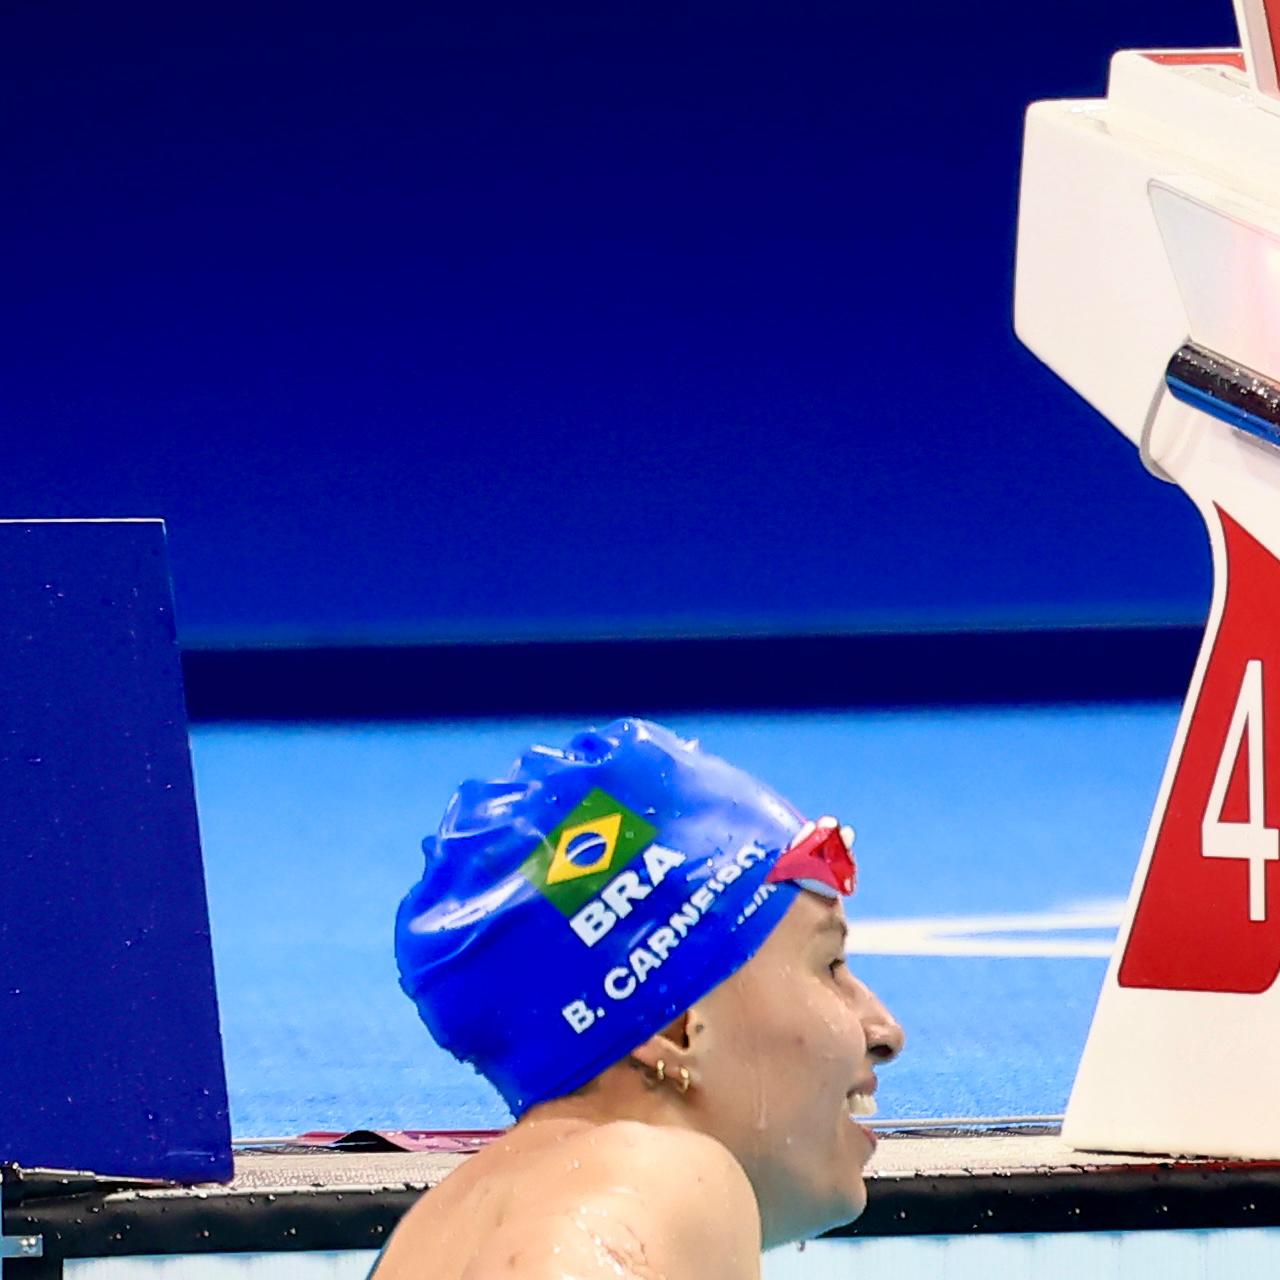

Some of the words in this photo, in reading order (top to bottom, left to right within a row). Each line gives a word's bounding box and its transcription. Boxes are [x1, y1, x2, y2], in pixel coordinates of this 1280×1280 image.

[1201, 659, 1280, 923] 4
[568, 842, 687, 947] BRA
[562, 1000, 605, 1034] B.
